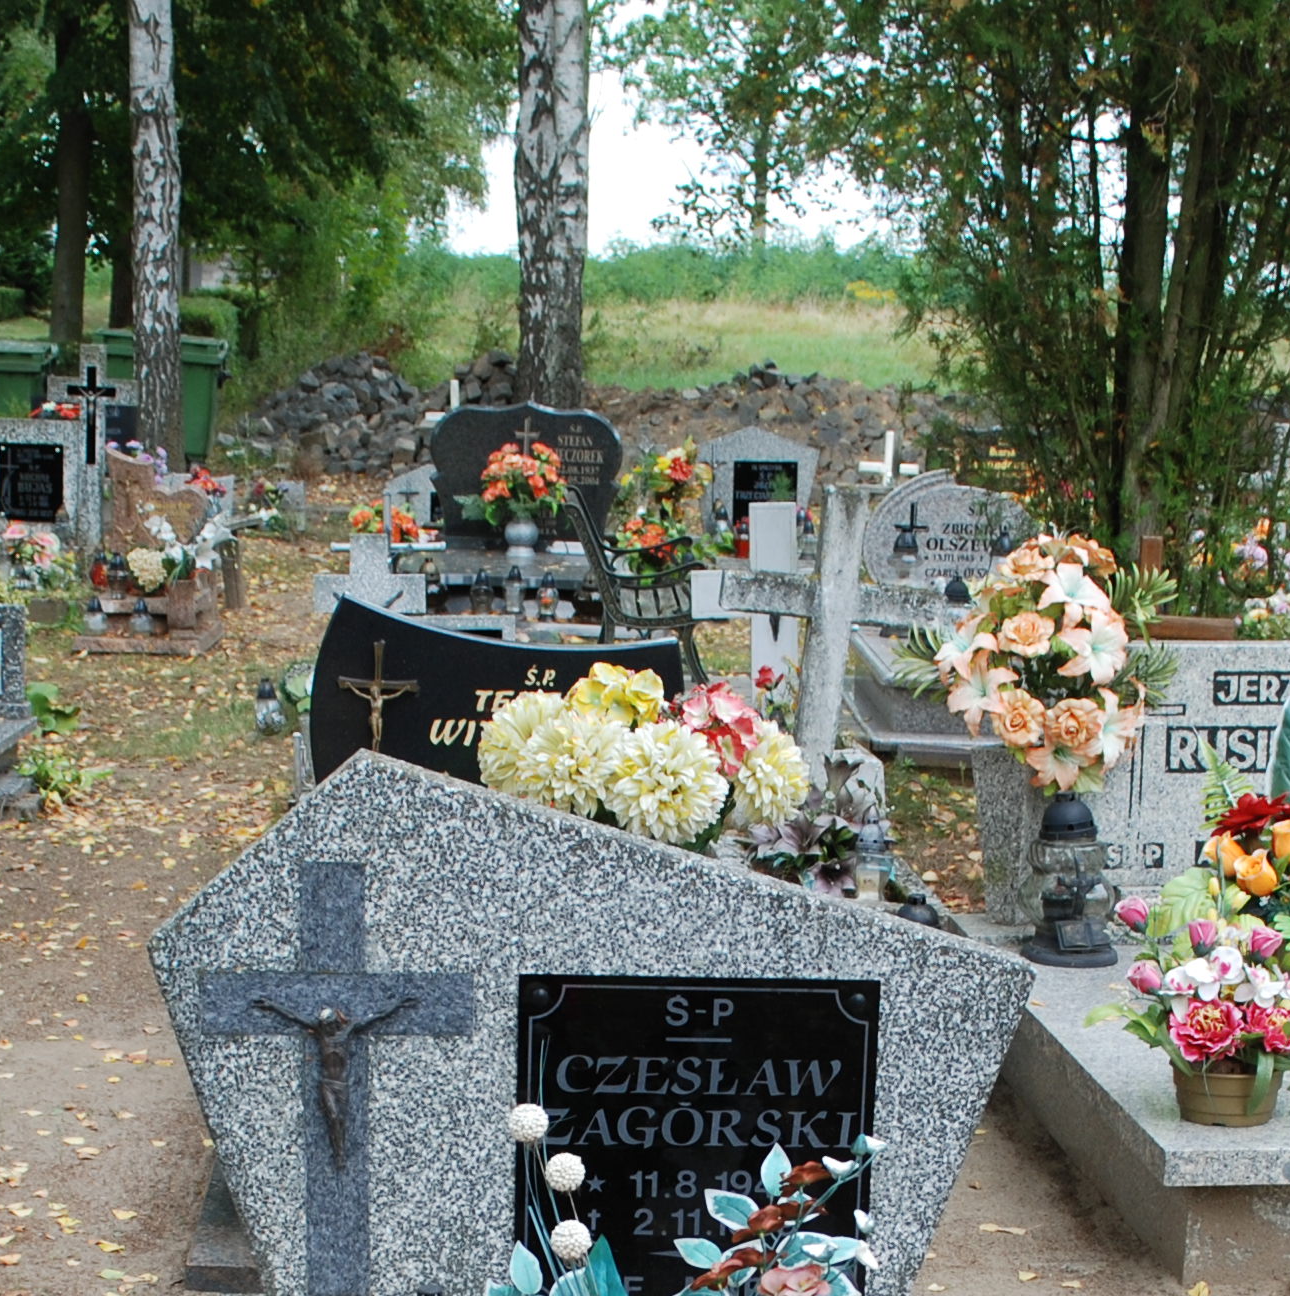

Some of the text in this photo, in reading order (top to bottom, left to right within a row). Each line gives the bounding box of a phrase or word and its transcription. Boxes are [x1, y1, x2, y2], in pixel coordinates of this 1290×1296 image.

[557, 435, 594, 448] STEFAN
[555, 1054, 842, 1097] CZESŁAW
[540, 1101, 858, 1149] ZAGÓRSKI
